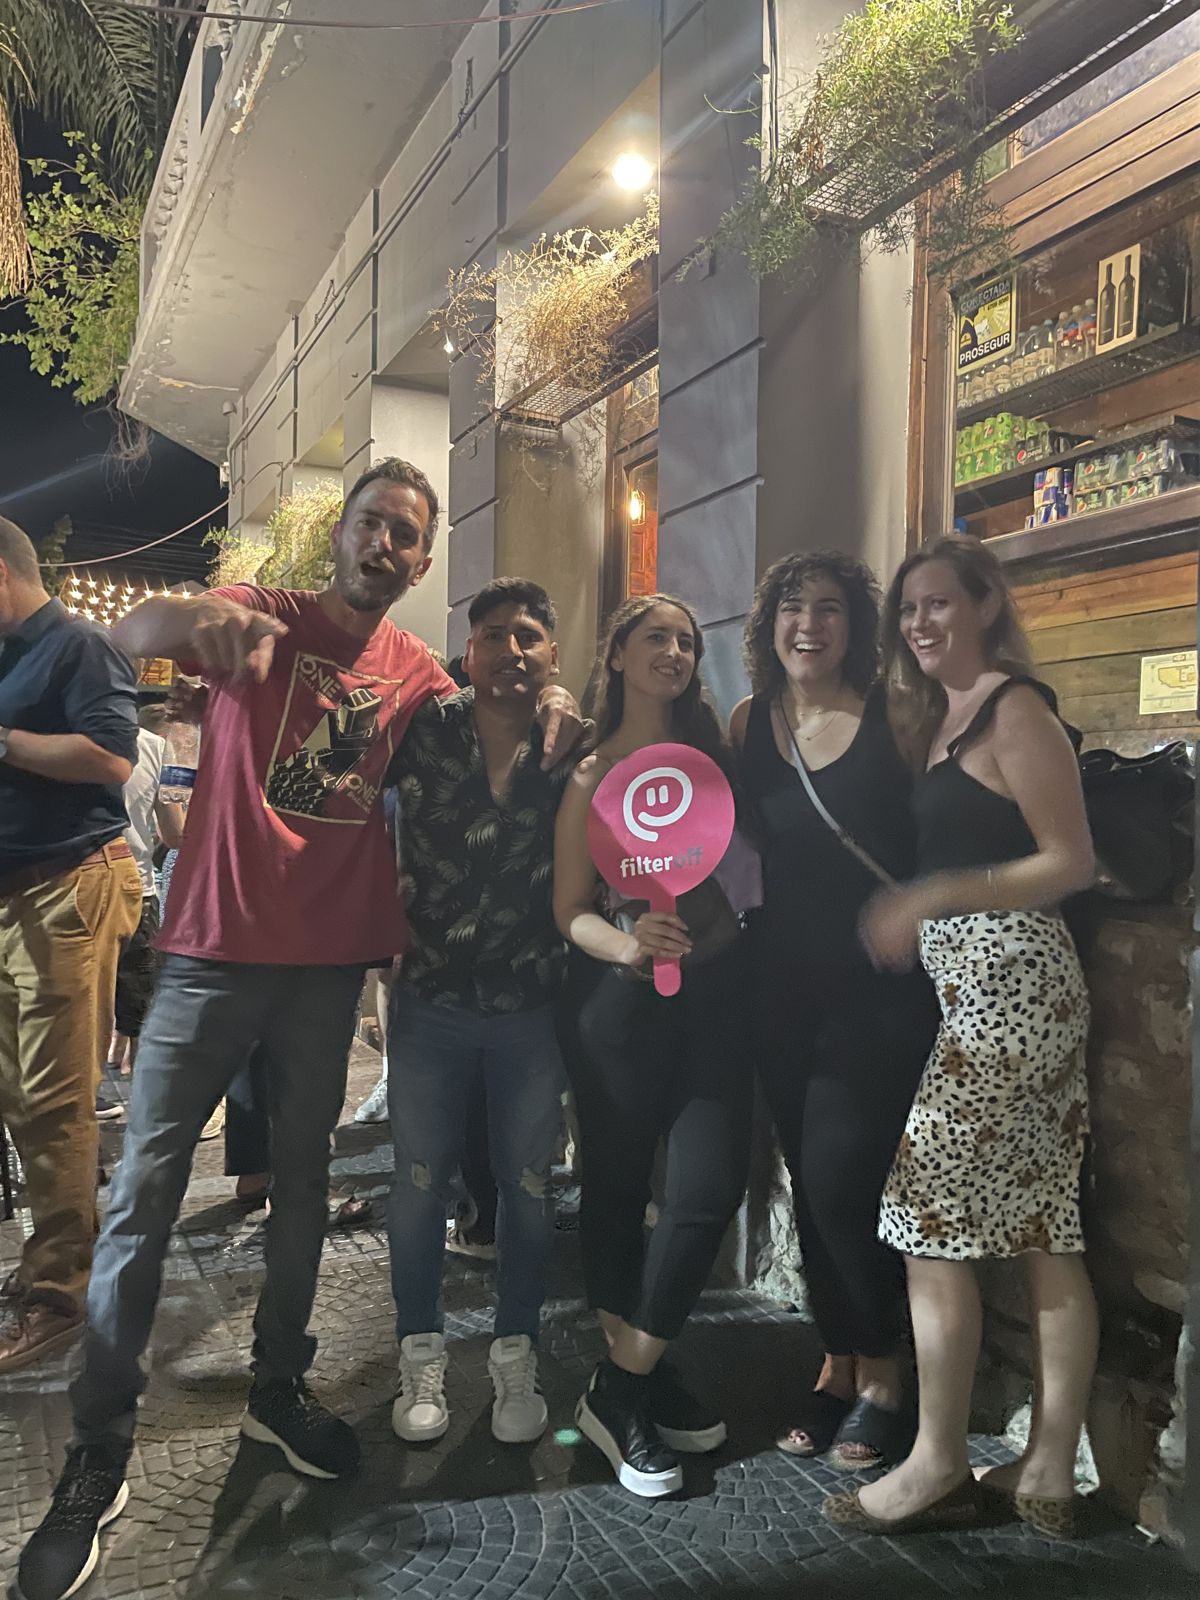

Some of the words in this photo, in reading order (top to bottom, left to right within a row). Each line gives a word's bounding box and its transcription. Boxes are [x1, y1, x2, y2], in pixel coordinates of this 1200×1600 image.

[960, 333, 1010, 365] PROSEGUR
[300, 659, 341, 699] ONE
[346, 773, 379, 806] ONE
